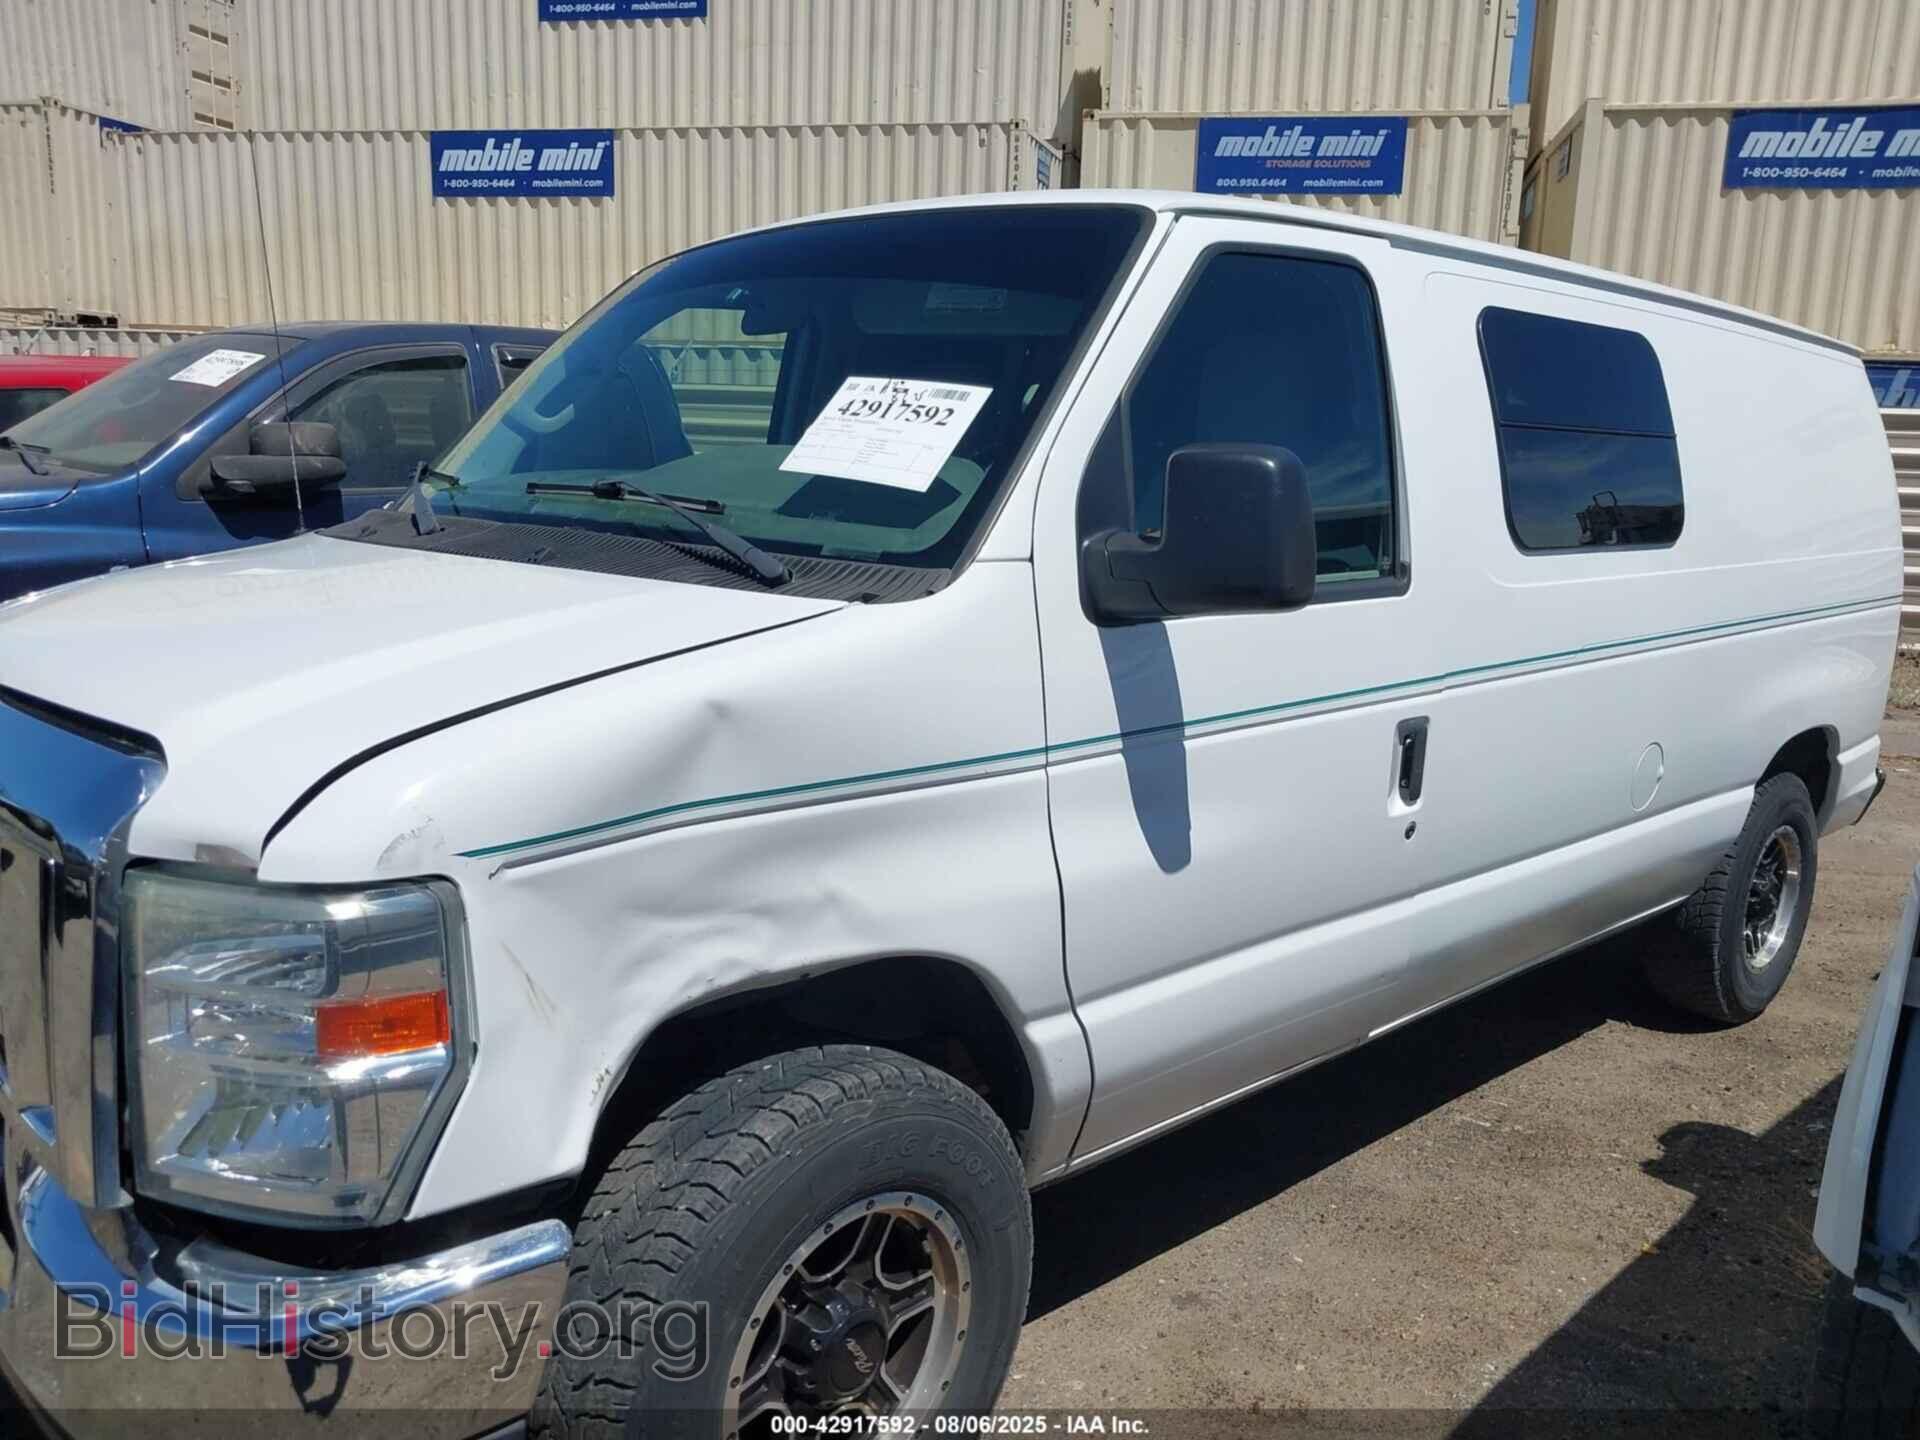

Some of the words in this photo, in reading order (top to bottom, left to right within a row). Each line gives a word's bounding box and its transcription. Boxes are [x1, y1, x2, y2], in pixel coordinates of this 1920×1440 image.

[1214, 126, 1313, 157] mobile
[1316, 129, 1387, 157] mini
[1738, 117, 1884, 158] mobile
[439, 138, 535, 171] mobile
[537, 142, 605, 171] mini
[1265, 159, 1312, 168] STORAGE
[1313, 159, 1371, 168] SOLUTIONS
[1742, 167, 1848, 178] 1-800-950-6464
[444, 179, 515, 188] 1-800-950-6464
[532, 178, 603, 187] mobilemini.com
[1216, 178, 1287, 187] 800.950.6464
[1303, 178, 1383, 187] mobilemini.com
[837, 398, 955, 426] 42917592
